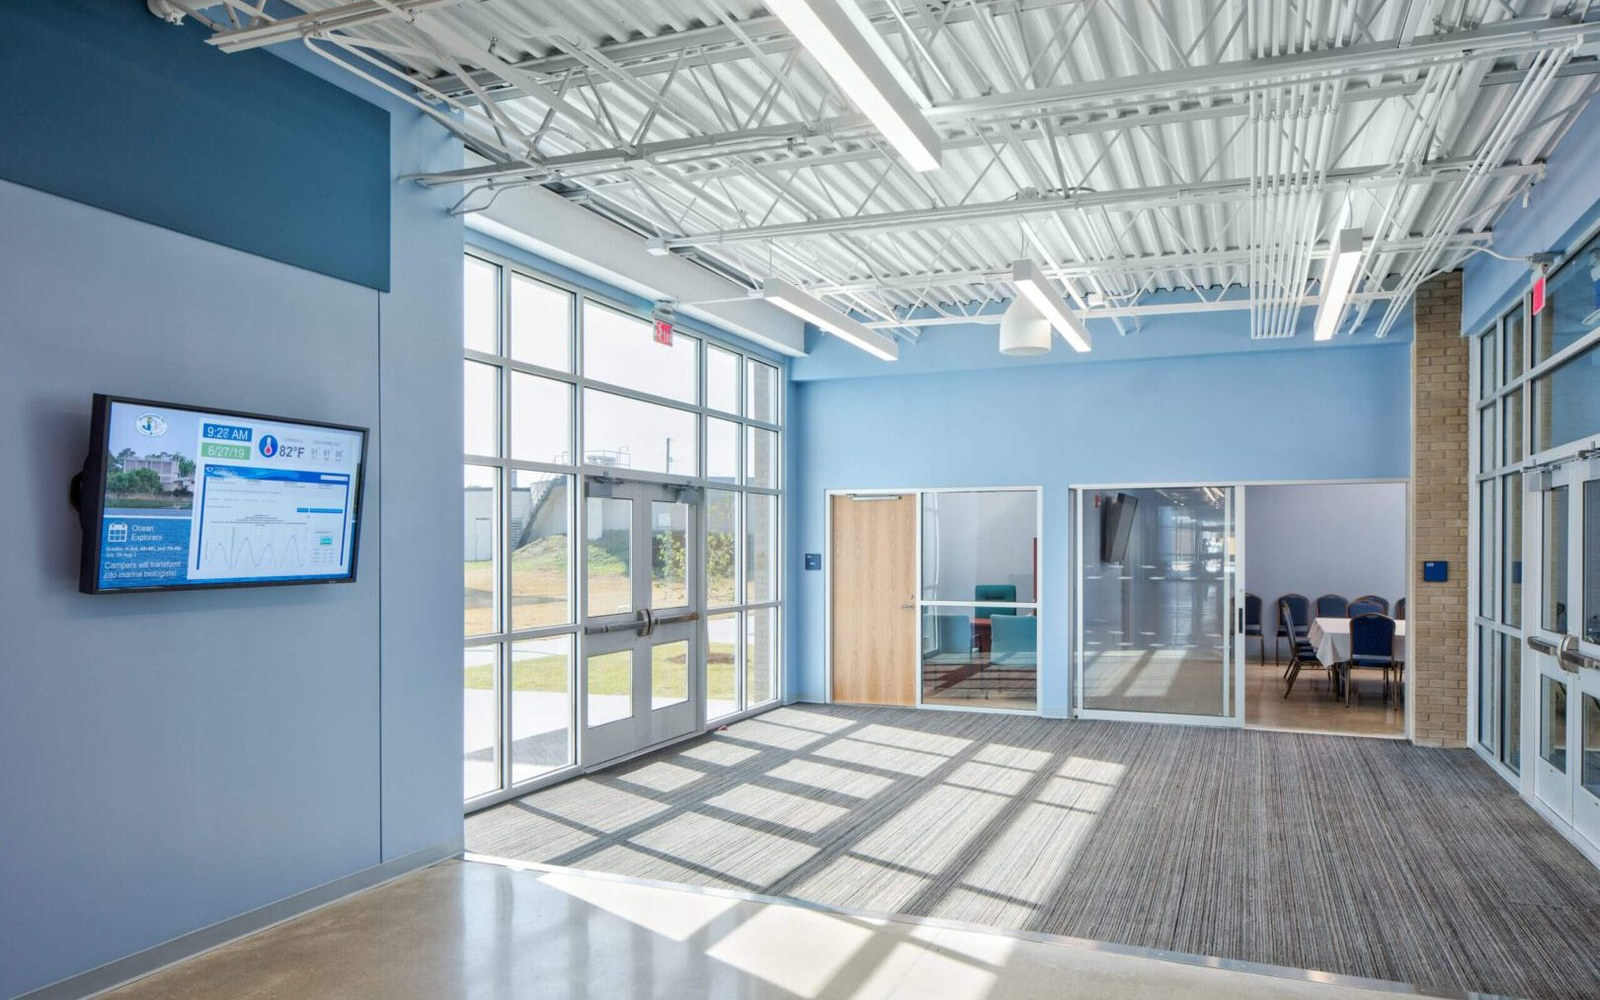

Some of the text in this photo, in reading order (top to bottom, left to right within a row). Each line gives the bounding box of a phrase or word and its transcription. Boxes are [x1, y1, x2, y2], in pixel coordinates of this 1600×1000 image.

[231, 429, 249, 440] AM
[279, 445, 305, 458] 82°F
[131, 524, 155, 532] Ocean
[131, 533, 163, 541] Explorers
[104, 561, 137, 570] Campers
